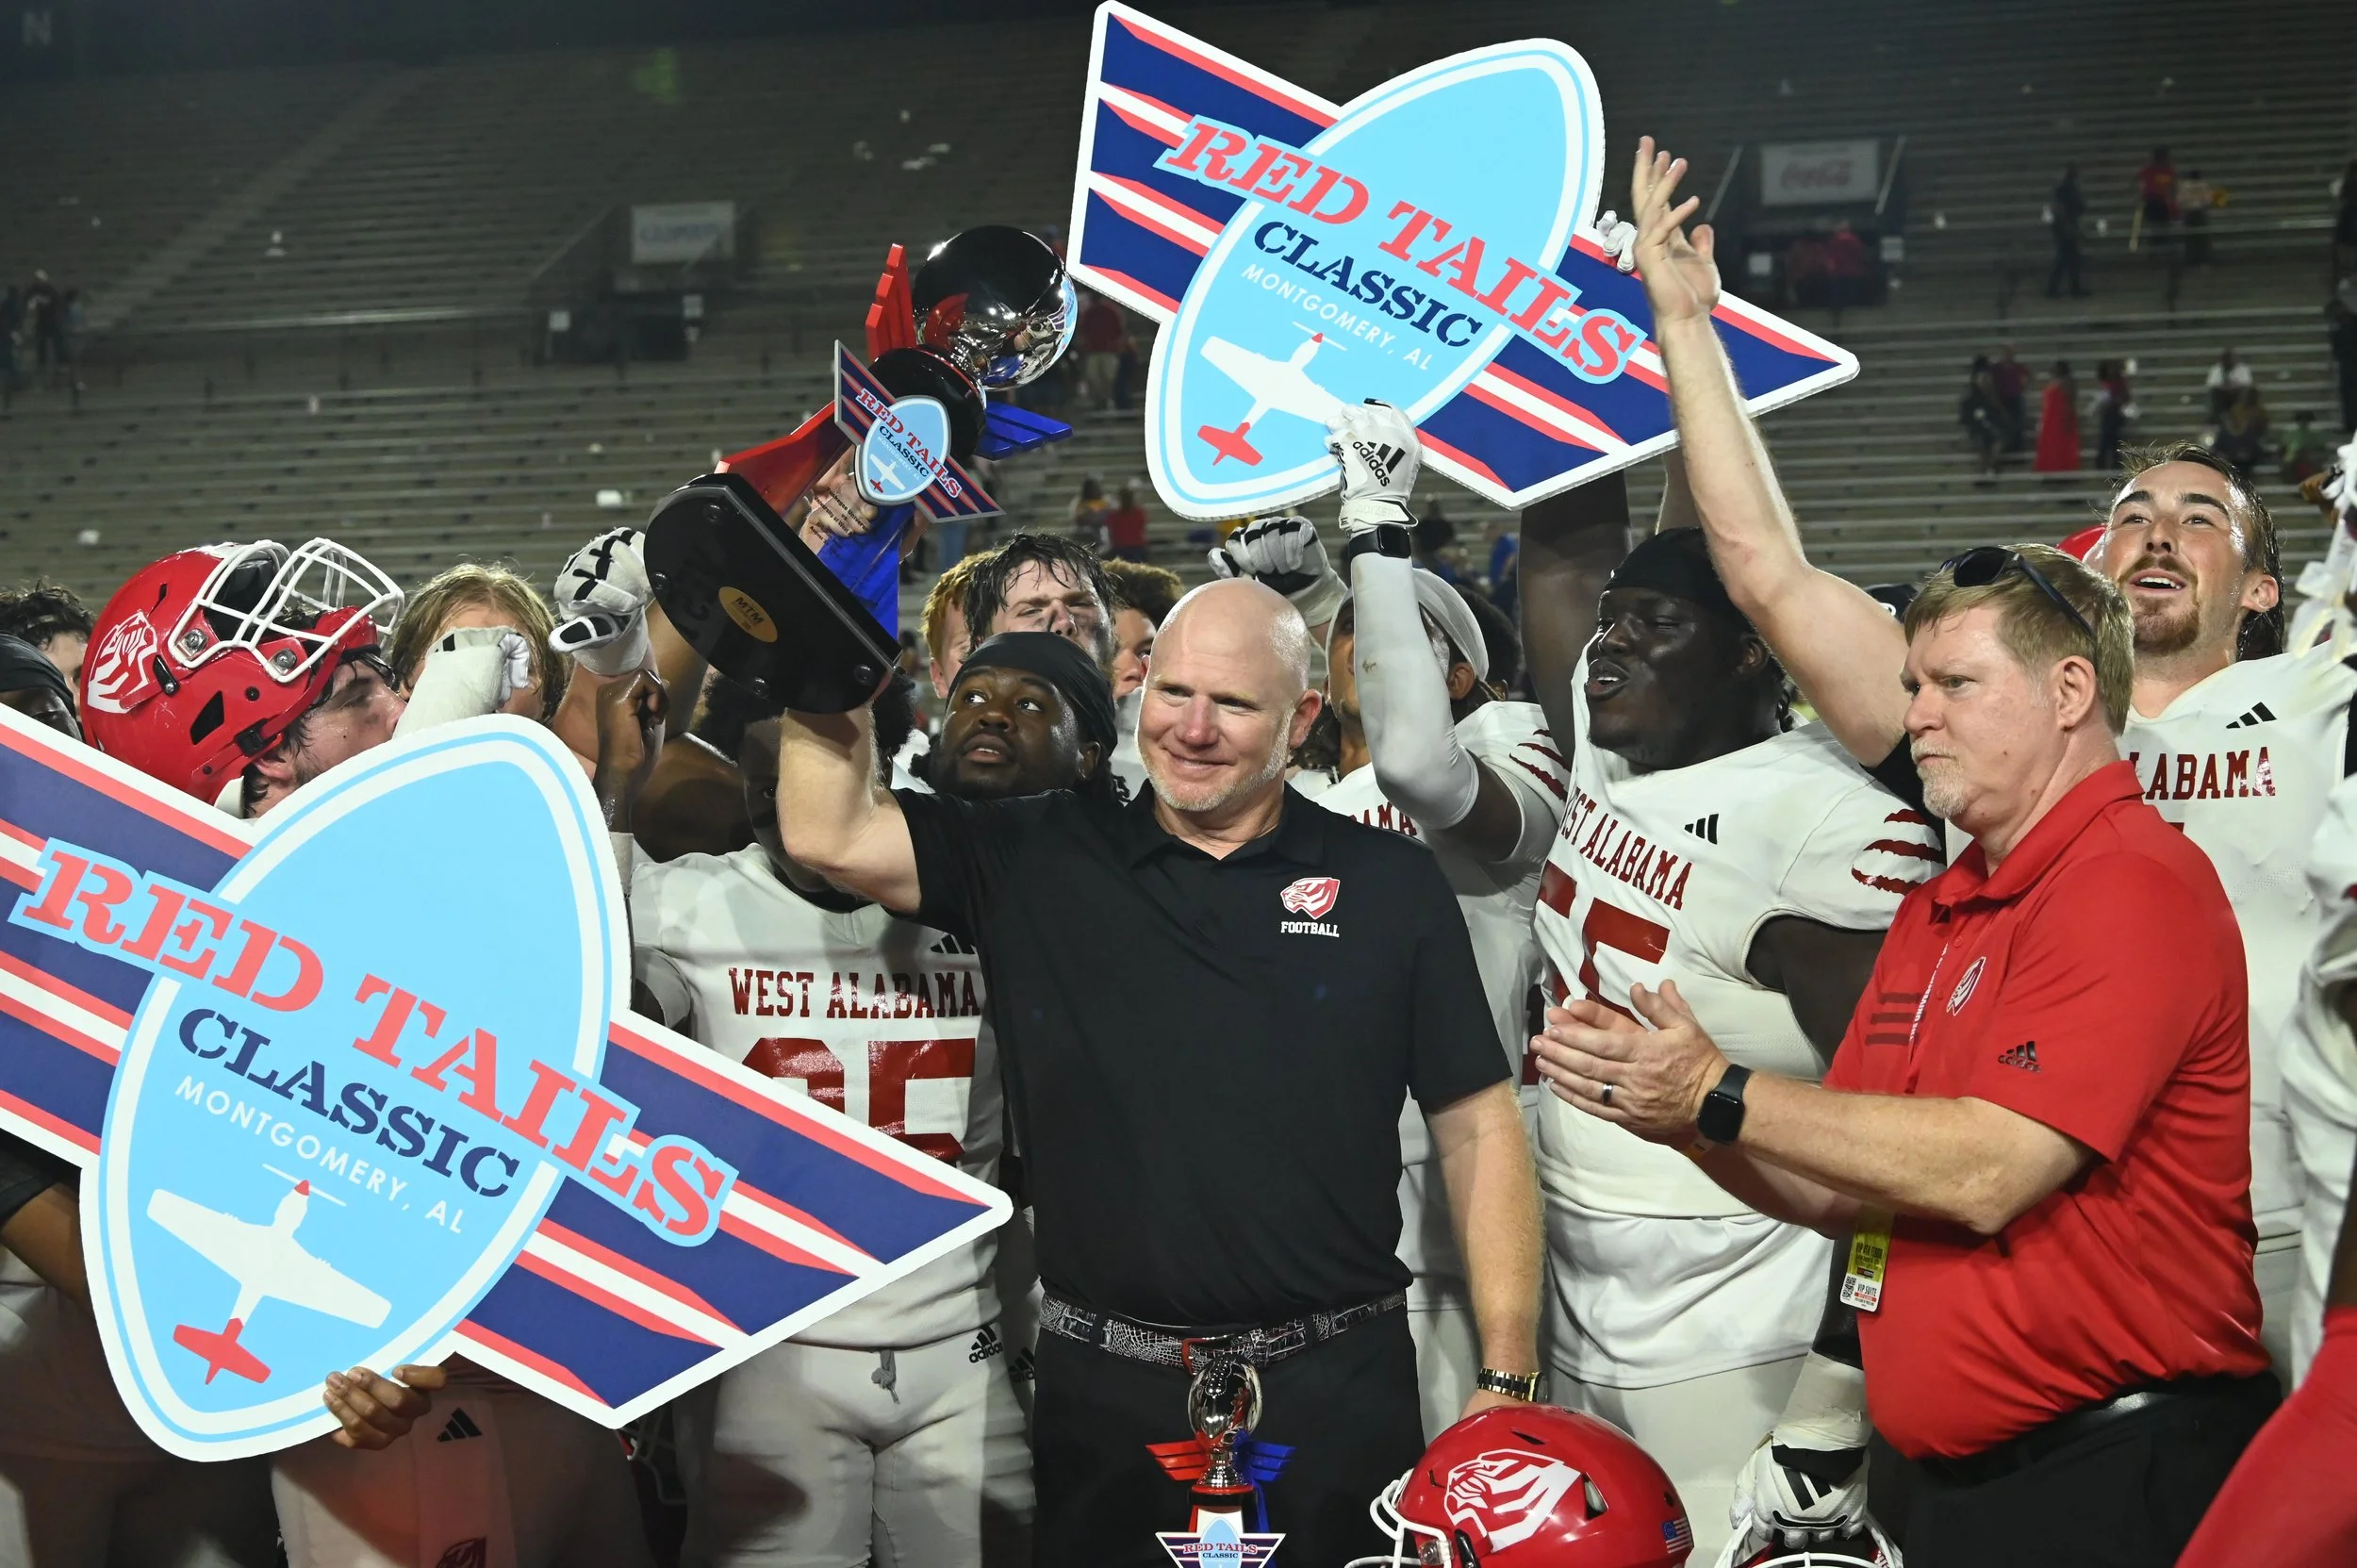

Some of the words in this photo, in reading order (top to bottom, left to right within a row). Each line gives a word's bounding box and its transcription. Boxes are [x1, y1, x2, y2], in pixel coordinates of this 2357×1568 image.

[1164, 123, 1370, 225] RED
[1377, 200, 1638, 377] TAILS
[1254, 221, 1483, 347] CLASSIC
[1241, 263, 1396, 355] MONTGOMERY,
[1403, 348, 1433, 371] AL
[859, 390, 904, 434] RED
[906, 432, 960, 496] TAILS
[879, 425, 930, 477] CLASSIC
[1352, 441, 1391, 487] adidas
[735, 597, 765, 624] MTM
[1579, 813, 1692, 911] ALABAMA
[1280, 921, 1340, 937] FOOTBALL
[729, 967, 814, 1017] WEST
[827, 971, 981, 1018] ALABAMA
[22, 850, 324, 1013] RED
[352, 973, 725, 1237] TAILS
[1998, 1054, 2042, 1074] adidas
[178, 1008, 520, 1197] CLASSIC
[174, 1076, 409, 1211] MONTGOMERY,
[425, 1200, 466, 1233] AL
[968, 1342, 1003, 1363] adida
[1184, 1543, 1213, 1553] RED
[1216, 1543, 1257, 1553] TAILS
